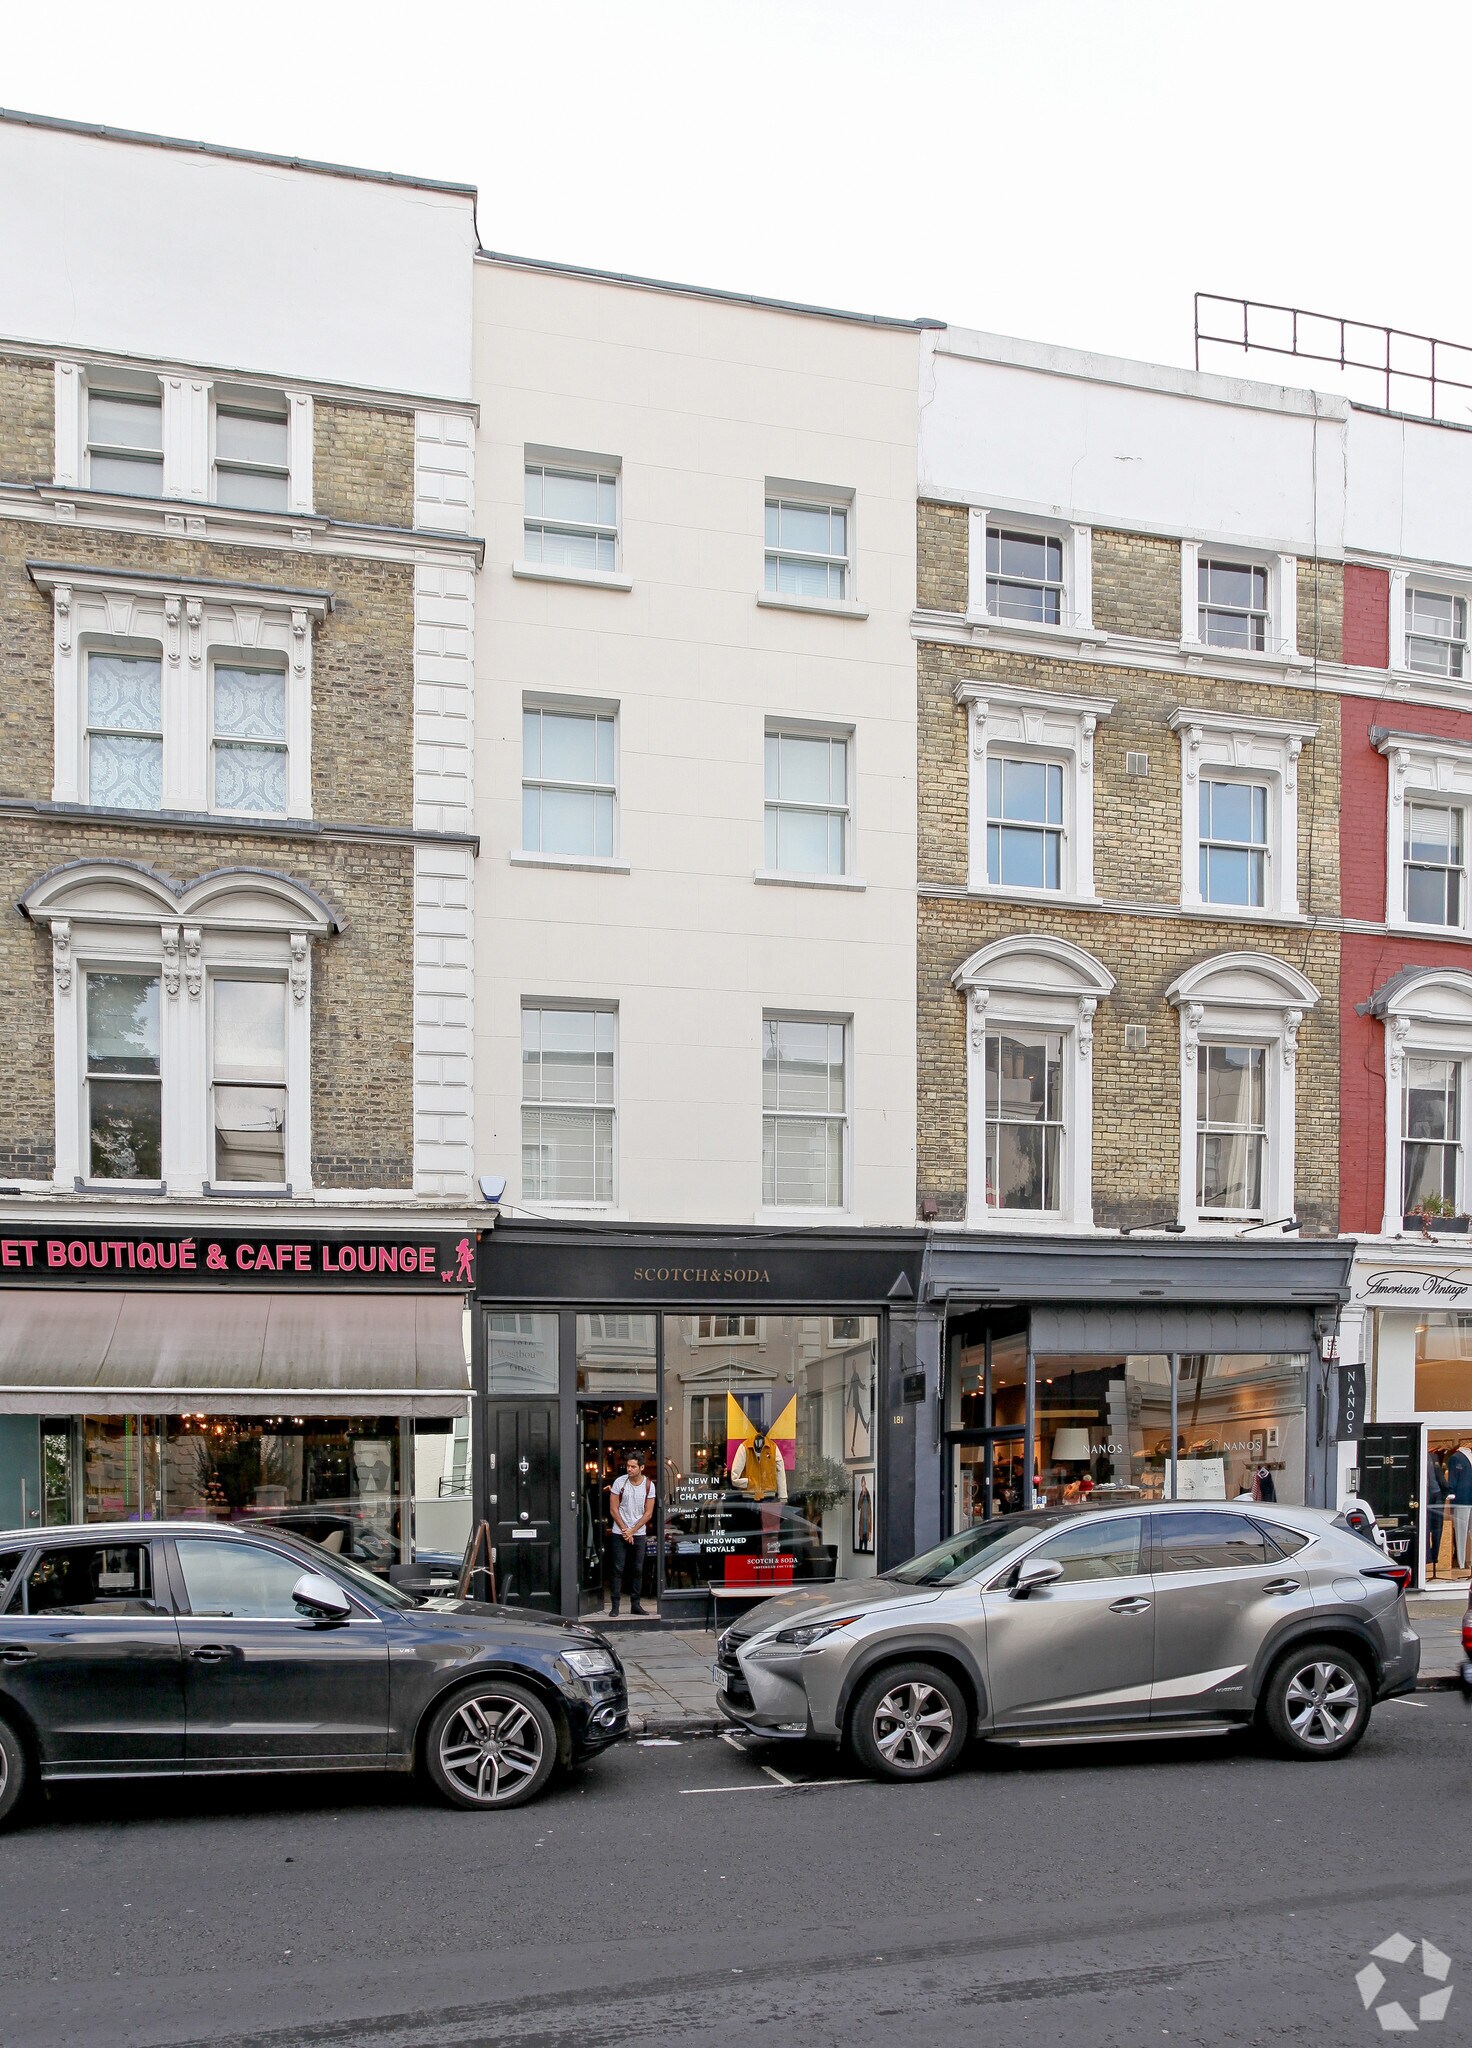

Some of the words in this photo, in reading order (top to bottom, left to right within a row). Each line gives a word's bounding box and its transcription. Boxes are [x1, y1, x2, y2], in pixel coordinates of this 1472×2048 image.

[47, 1237, 196, 1269] BOUTIQUÉ
[206, 1243, 229, 1270] &
[236, 1244, 312, 1271] CAFE
[322, 1246, 436, 1272] LOUNGE
[634, 1268, 770, 1283] SCOTCH&SODA
[1356, 1273, 1421, 1299] American
[1423, 1269, 1469, 1301] Vintage
[1346, 1371, 1356, 1434] NANOS
[893, 1415, 904, 1424] 181
[1082, 1444, 1123, 1454] NANOS
[1223, 1441, 1262, 1451] NANOS
[1383, 1456, 1394, 1465] 185
[688, 1477, 708, 1485] NEW
[721, 1492, 726, 1500] 2
[698, 1537, 747, 1545] UNCROWNED
[706, 1545, 736, 1553] ROYALS
